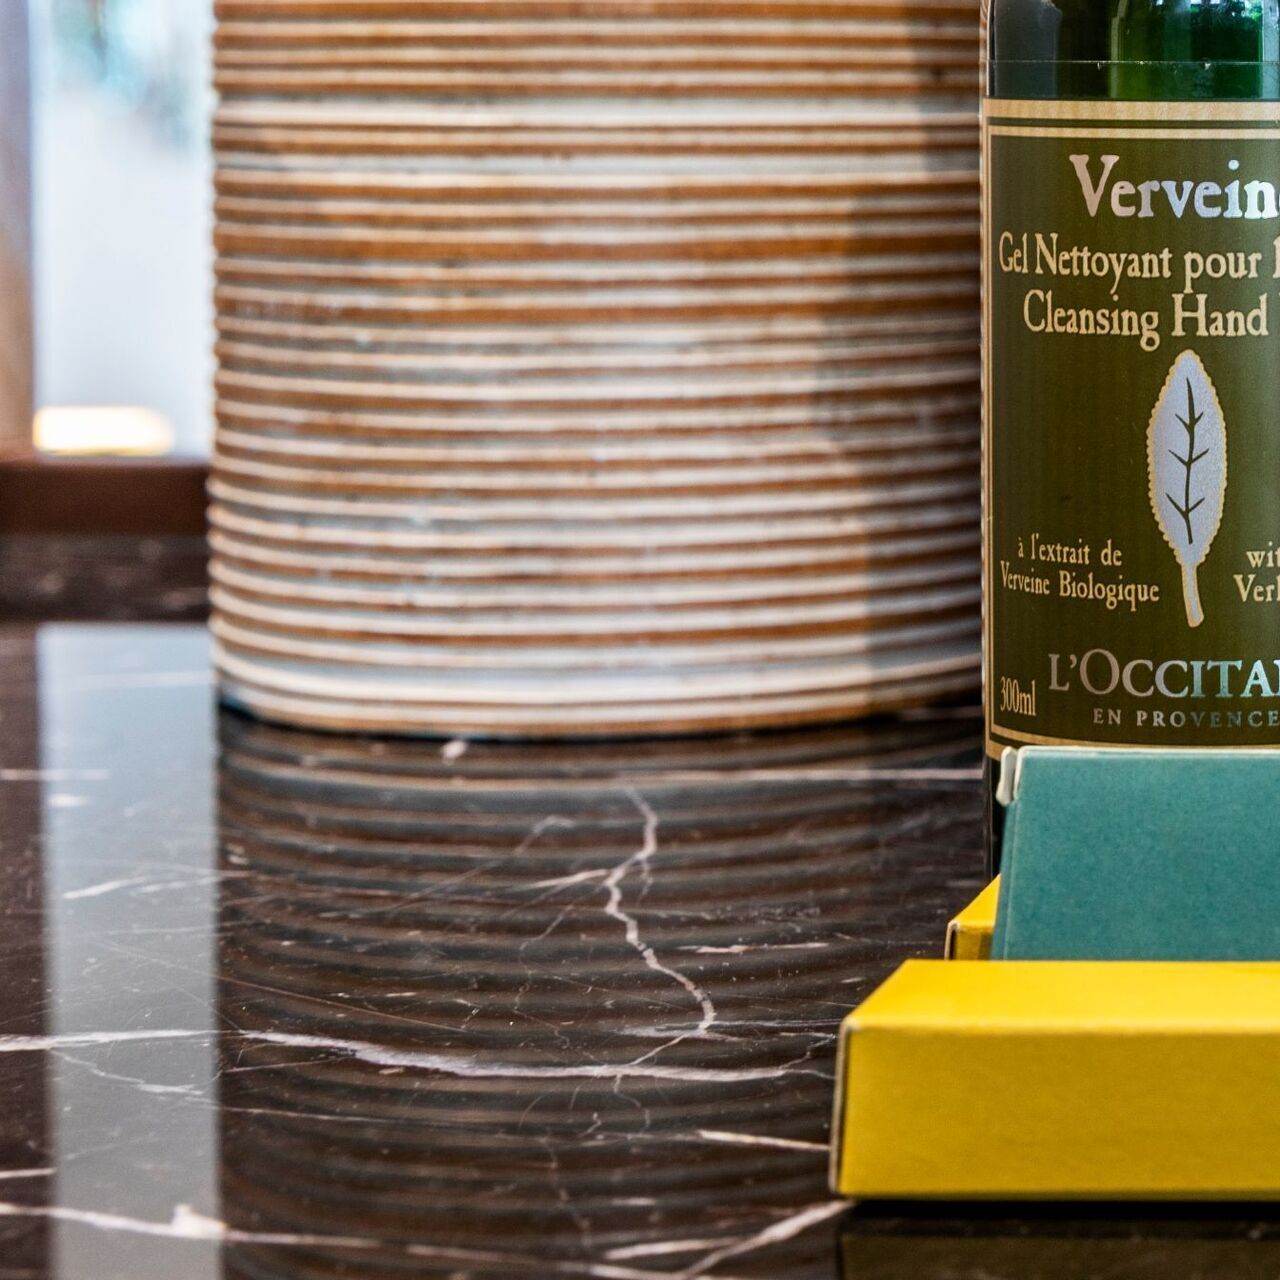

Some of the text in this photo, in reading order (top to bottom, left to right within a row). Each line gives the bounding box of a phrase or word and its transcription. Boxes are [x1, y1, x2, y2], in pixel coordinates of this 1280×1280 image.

[999, 231, 1028, 274] Gel
[1035, 232, 1172, 295] Nettoyant
[1184, 243, 1262, 293] pour
[1023, 289, 1160, 352] Cleansing
[1171, 292, 1269, 337] Hand
[1030, 532, 1090, 565] l'extrait
[1100, 539, 1122, 567] de
[1000, 560, 1160, 612] Verveine Biologique
[1000, 676, 1036, 717] 300ml
[1093, 707, 1280, 728] EN PROVENCE
